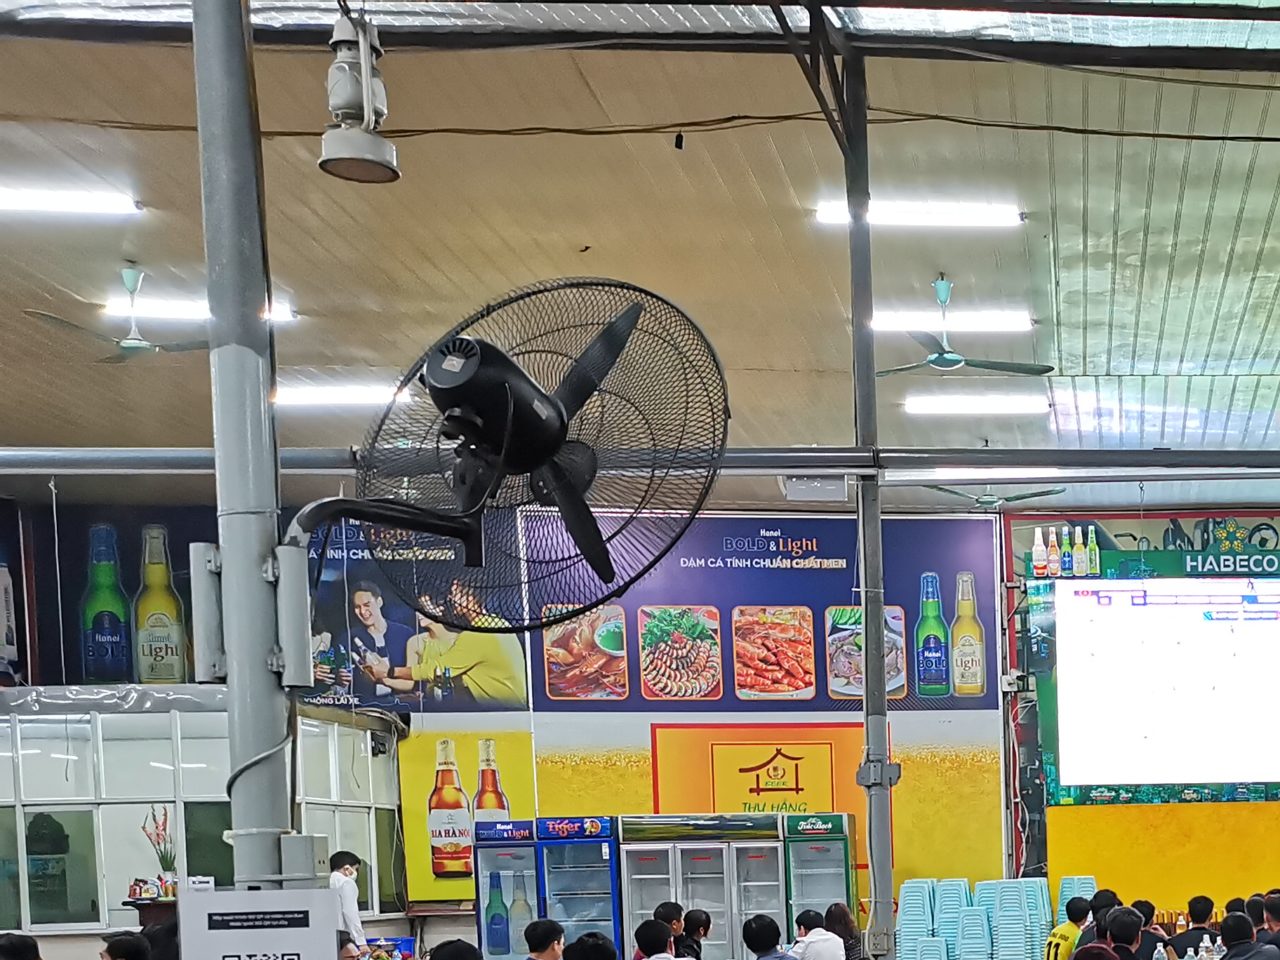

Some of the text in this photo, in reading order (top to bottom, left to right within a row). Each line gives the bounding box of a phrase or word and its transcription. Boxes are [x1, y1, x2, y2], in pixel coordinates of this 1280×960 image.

[723, 537, 818, 556] BOLD & Light
[707, 557, 724, 567] CÁ
[727, 556, 751, 567] TÍNH
[1186, 555, 1279, 572] HABECO
[955, 658, 980, 671] Light
[742, 802, 768, 812] THU
[546, 819, 581, 837] Tiger
